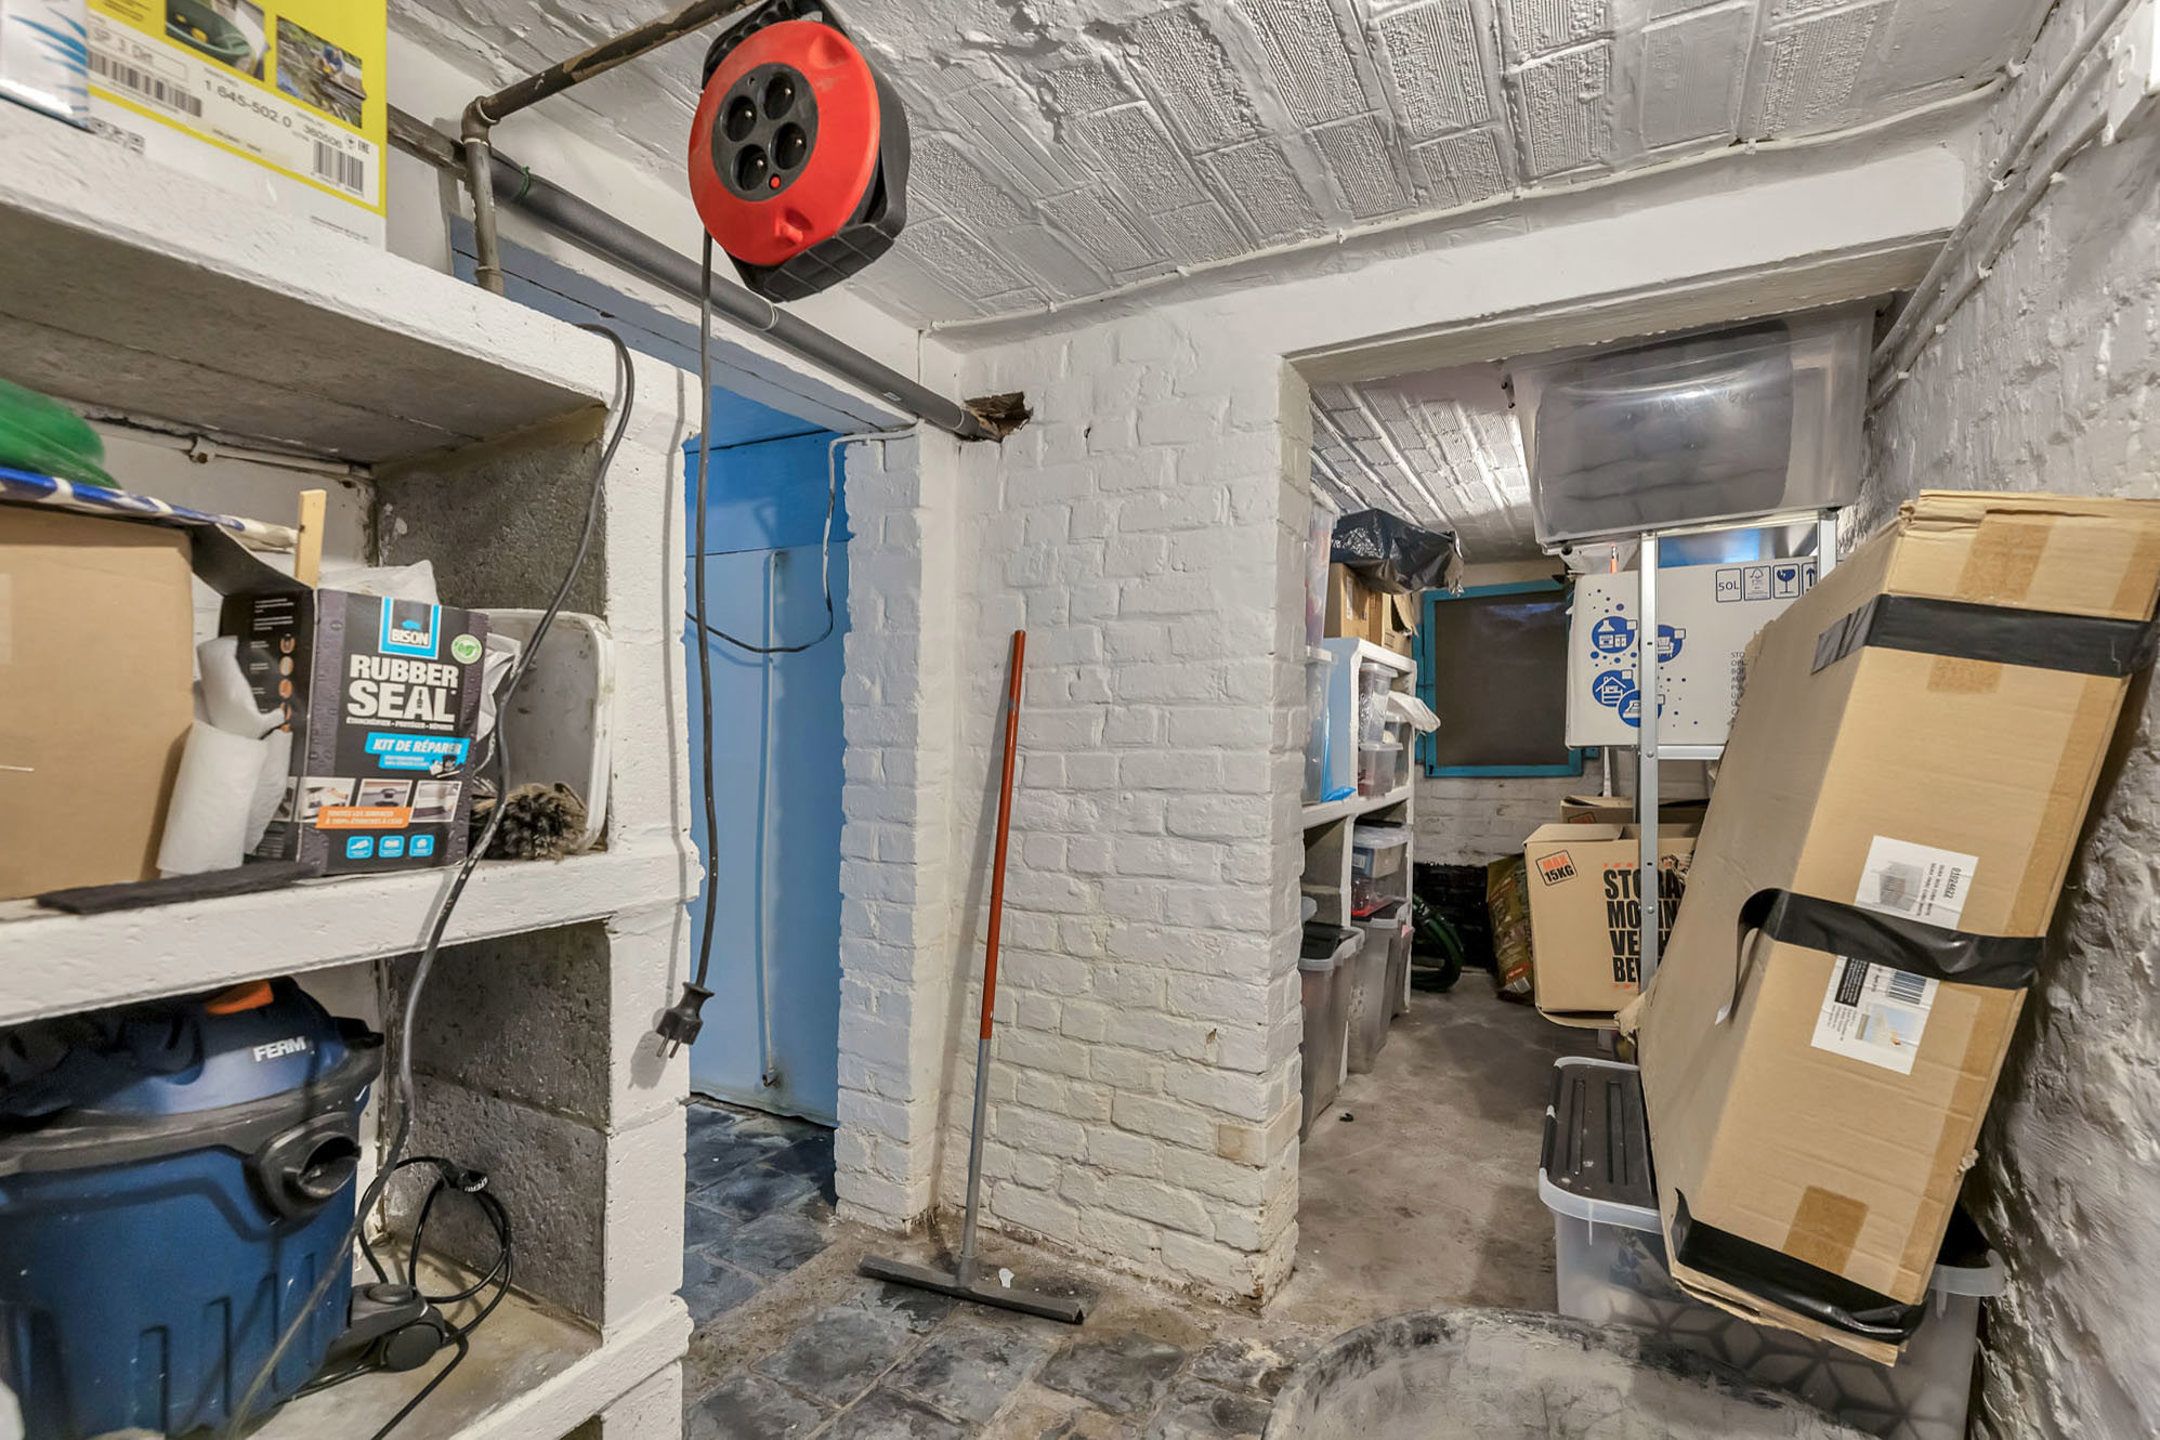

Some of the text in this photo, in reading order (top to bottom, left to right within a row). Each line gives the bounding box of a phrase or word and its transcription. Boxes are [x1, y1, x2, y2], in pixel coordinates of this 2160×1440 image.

[391, 628, 429, 646] BISON
[349, 654, 459, 688] RUBBER
[347, 678, 455, 723] SEAL
[372, 738, 395, 750] KIT
[395, 739, 413, 752] DE
[1544, 865, 1575, 882] 15KG
[253, 1036, 307, 1062] FERM
